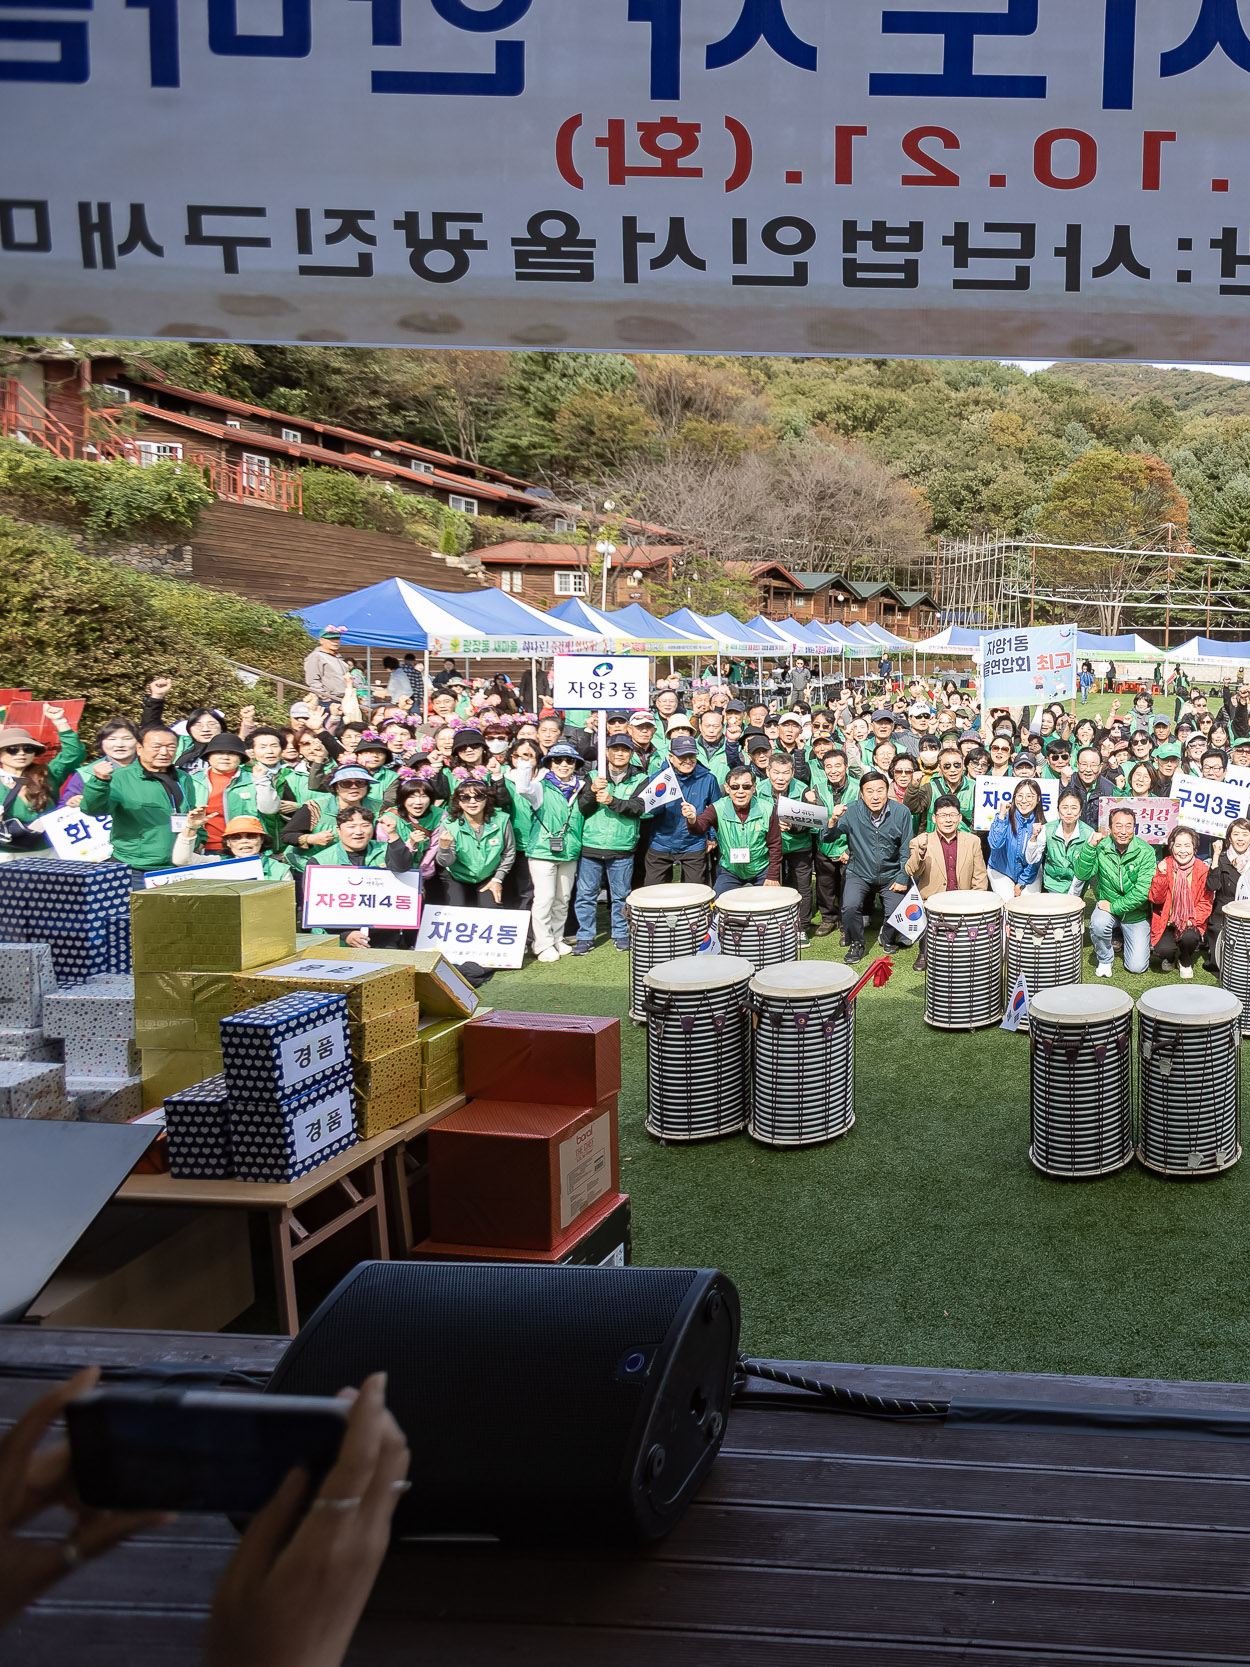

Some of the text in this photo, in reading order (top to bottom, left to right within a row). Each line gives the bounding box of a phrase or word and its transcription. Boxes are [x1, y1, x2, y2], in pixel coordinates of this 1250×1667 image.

[987, 634, 1029, 656] 자양1동
[1036, 652, 1072, 671] 최고
[567, 681, 638, 699] 자양3동
[983, 791, 1051, 812] 자동
[1176, 788, 1241, 819] 구의3동
[315, 893, 412, 910] 자양제4동
[427, 921, 519, 946] 자양4동
[293, 1034, 335, 1069] 경품
[304, 1107, 342, 1143] 경품
